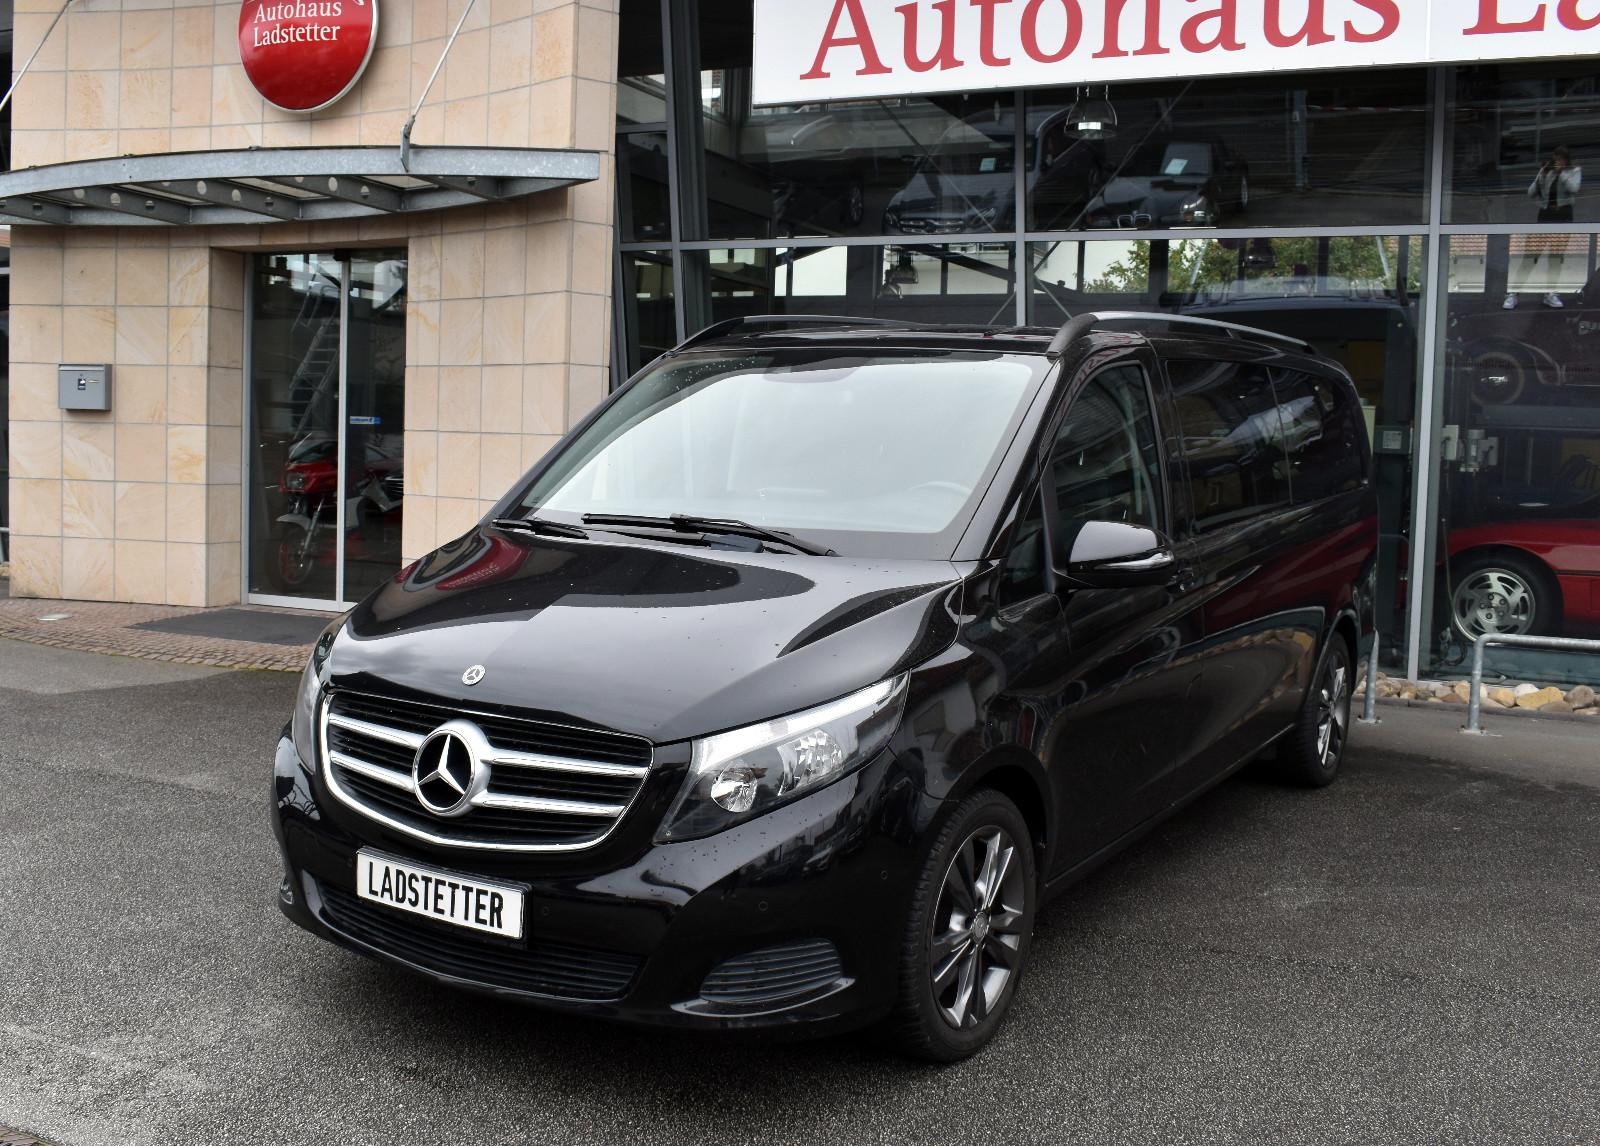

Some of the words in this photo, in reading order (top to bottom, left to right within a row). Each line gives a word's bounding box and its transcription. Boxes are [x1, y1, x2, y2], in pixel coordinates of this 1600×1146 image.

[253, 0, 342, 23] Autohaus
[253, 23, 341, 47] Ladstetter
[368, 861, 504, 929] LADSTETTER
